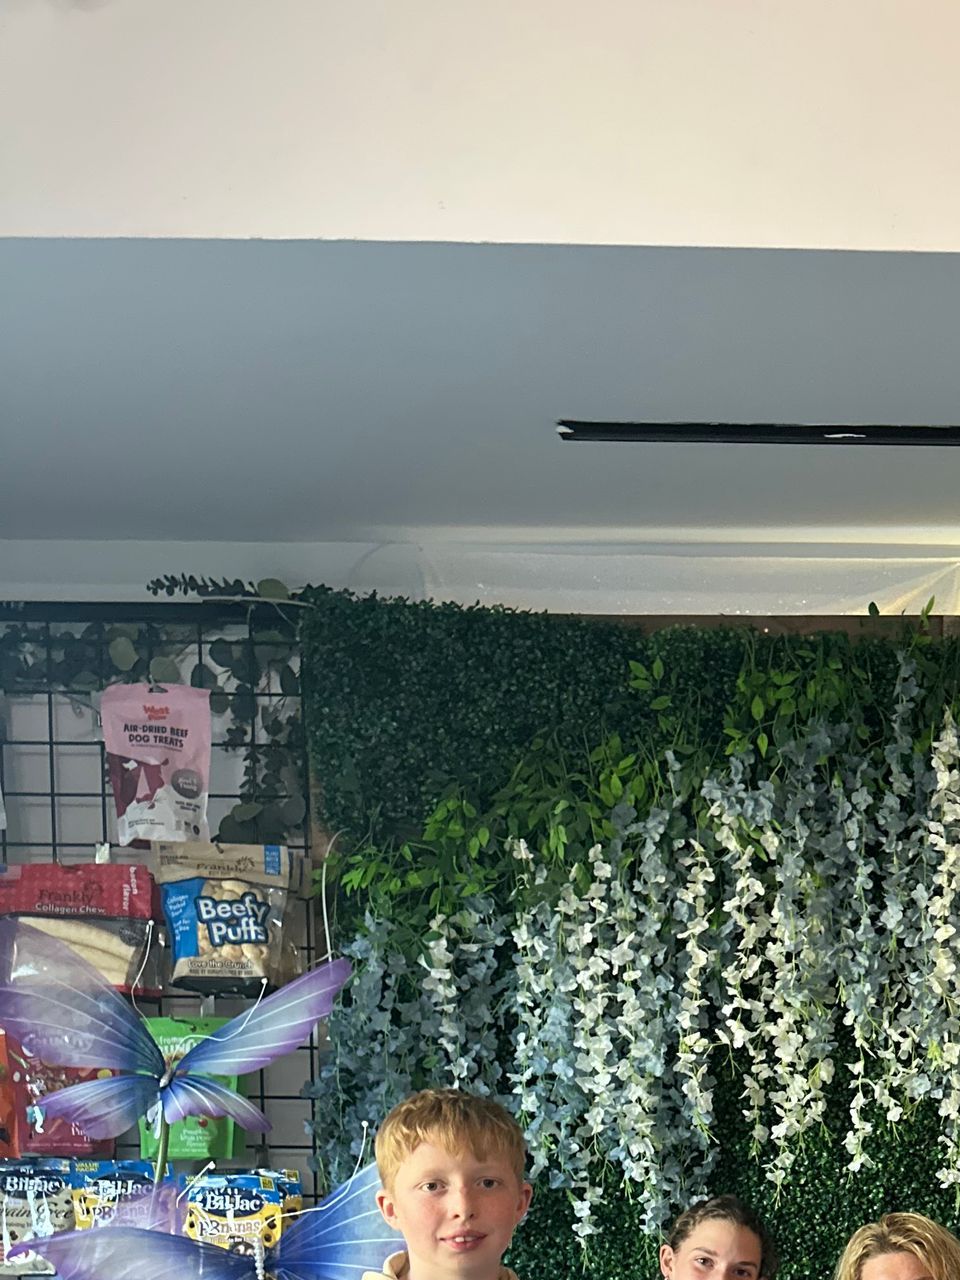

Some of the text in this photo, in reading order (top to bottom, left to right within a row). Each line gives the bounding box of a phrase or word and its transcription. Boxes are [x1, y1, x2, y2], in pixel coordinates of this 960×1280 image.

[124, 723, 189, 738] AIR-DRIED BEEF
[128, 734, 150, 743] DOG
[153, 735, 184, 748] TREATS
[35, 902, 78, 914] Collagen
[198, 895, 266, 922] Beefy
[211, 917, 266, 944] Puffs
